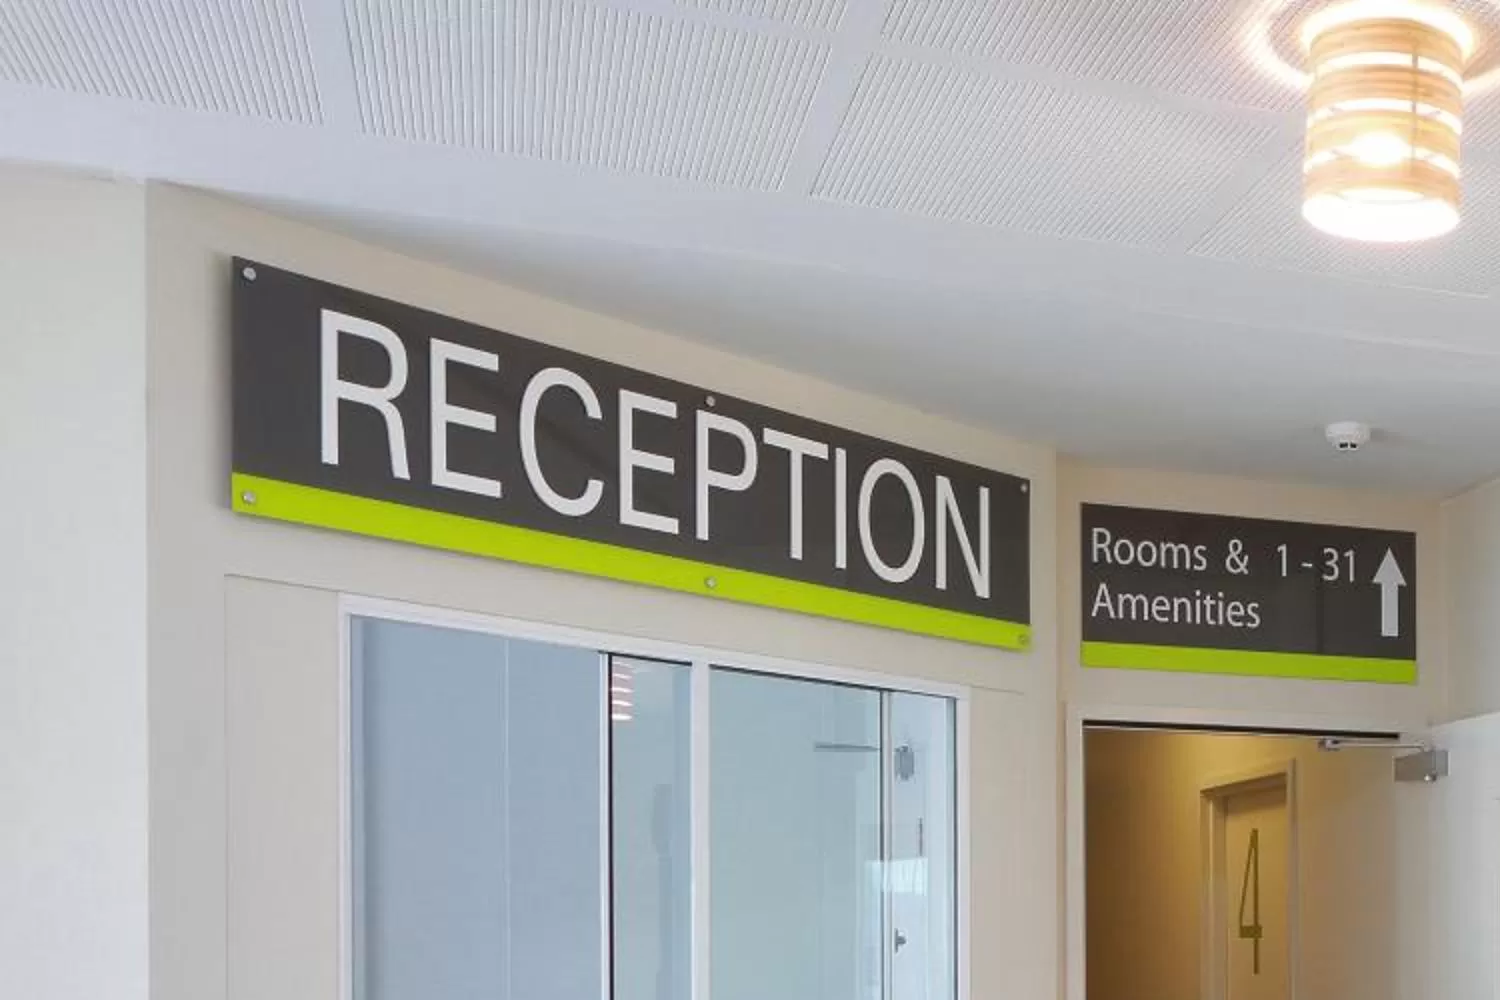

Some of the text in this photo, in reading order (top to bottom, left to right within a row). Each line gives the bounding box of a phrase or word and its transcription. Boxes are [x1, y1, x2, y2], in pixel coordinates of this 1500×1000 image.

[320, 309, 990, 599] RECEPTION
[1091, 527, 1207, 572] Rooms
[1225, 538, 1249, 576] &
[1091, 582, 1262, 628] Amenities
[1239, 828, 1263, 975] 4
